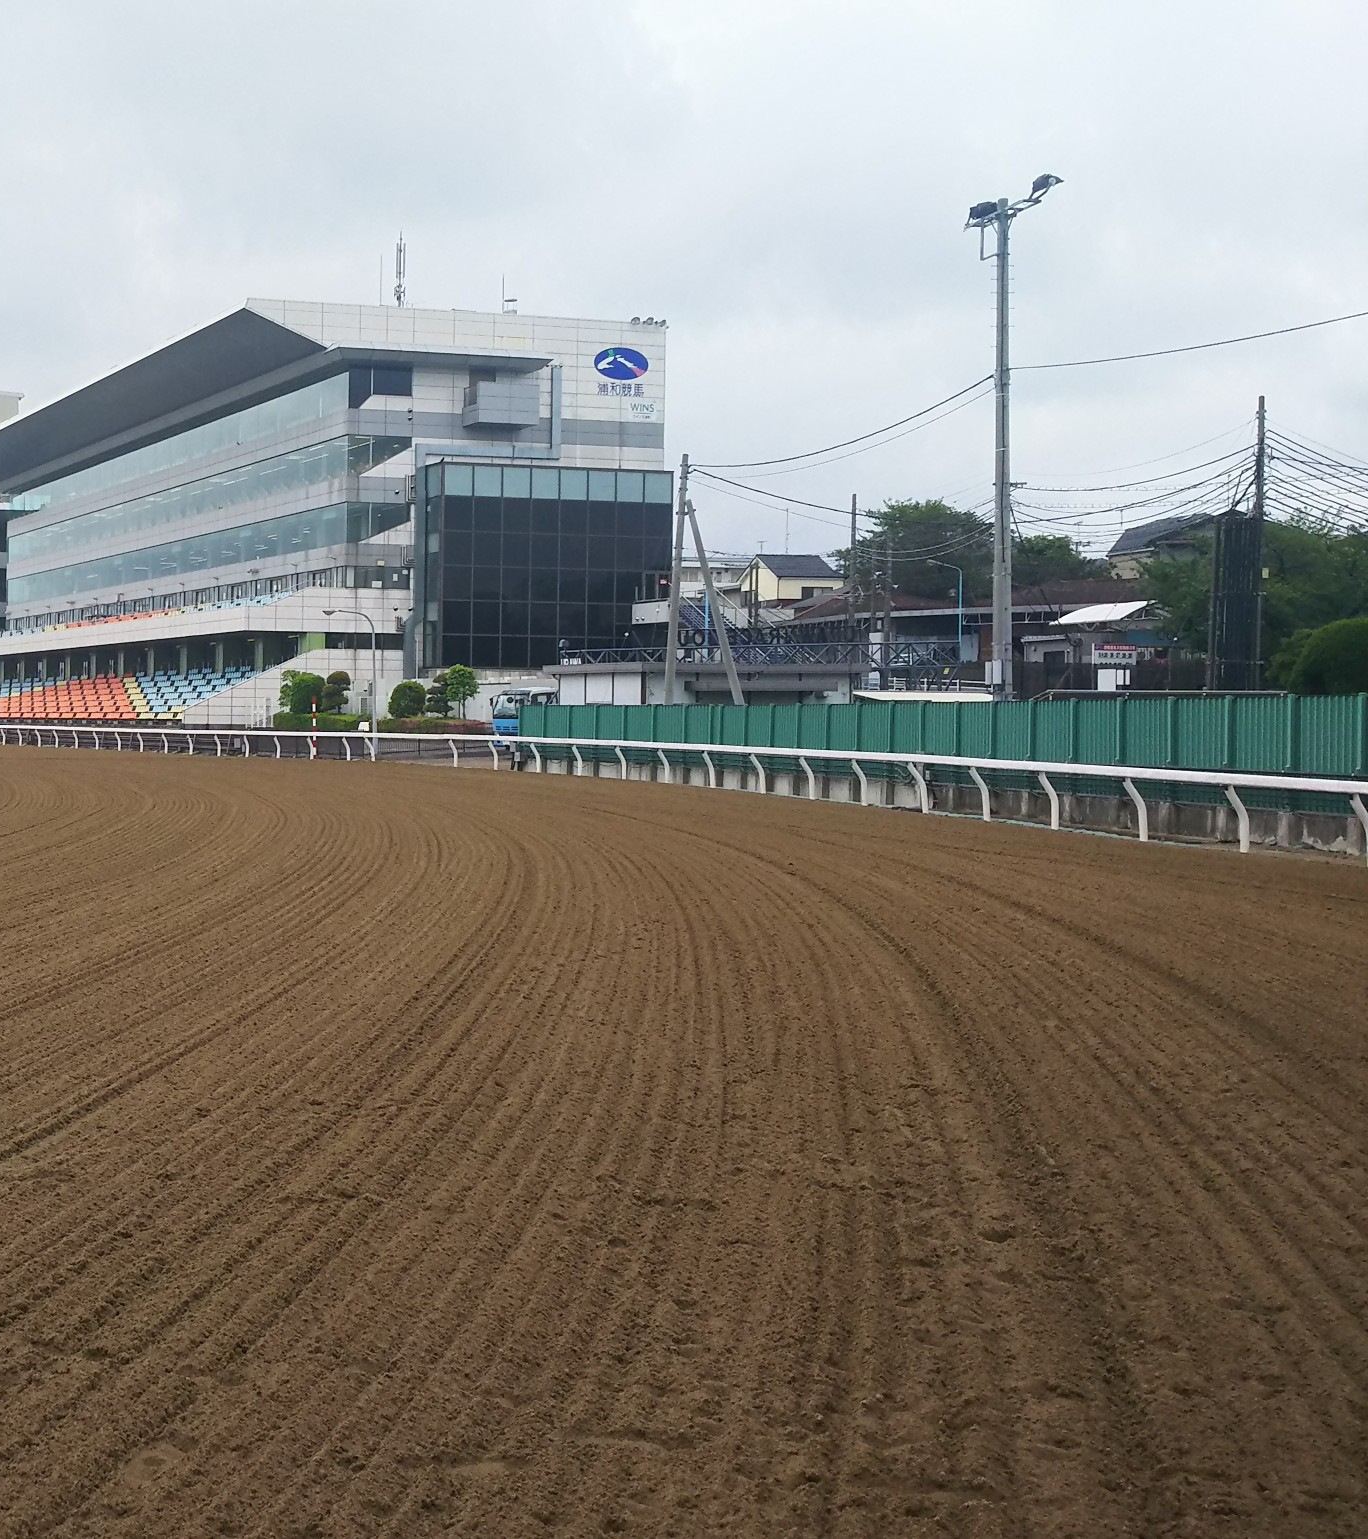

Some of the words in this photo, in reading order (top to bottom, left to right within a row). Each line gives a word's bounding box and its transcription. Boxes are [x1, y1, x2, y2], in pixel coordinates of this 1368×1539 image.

[597, 382, 644, 397] 浦和競馬
[630, 402, 655, 412] WINS
